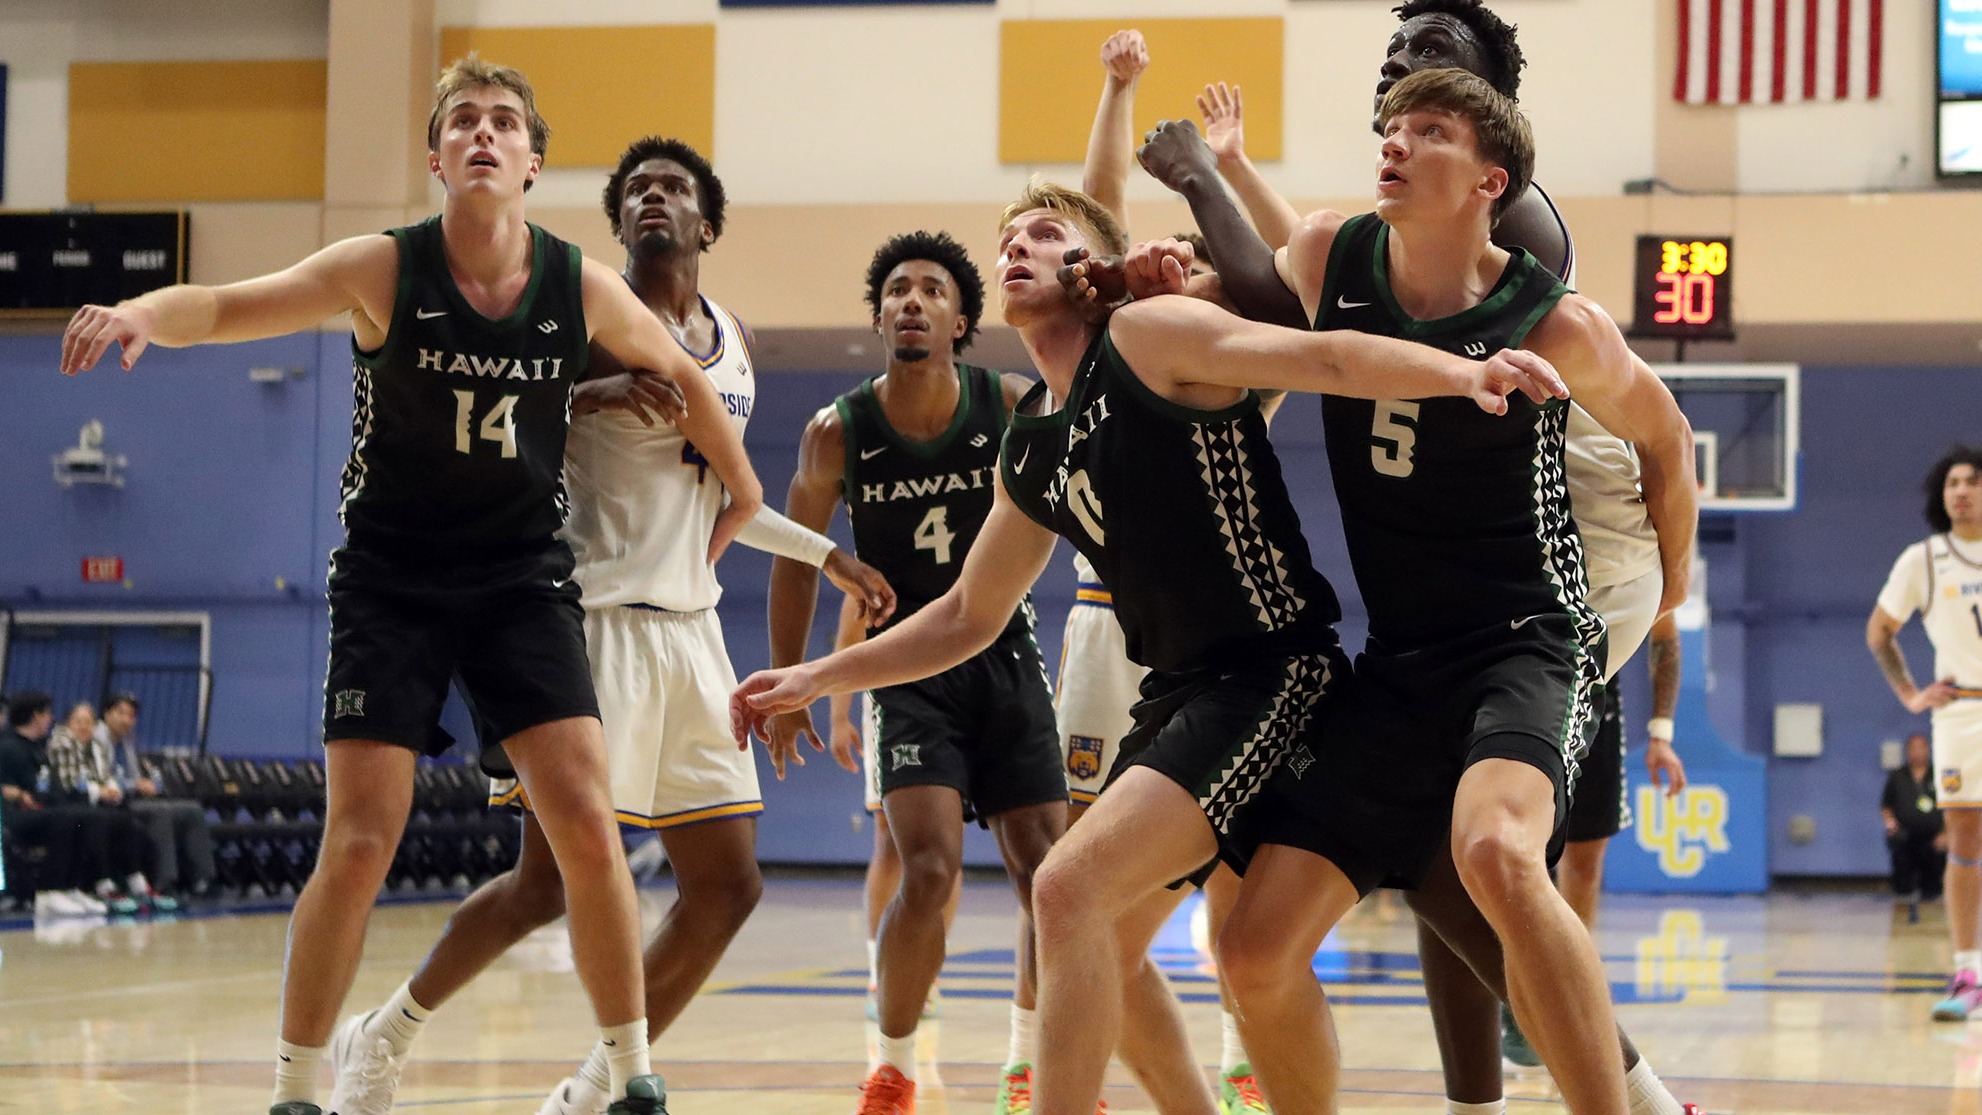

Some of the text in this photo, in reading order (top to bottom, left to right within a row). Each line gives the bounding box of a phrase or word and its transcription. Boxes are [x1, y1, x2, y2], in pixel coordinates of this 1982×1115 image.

[1661, 240, 1728, 275] 3:30
[1653, 271, 1714, 324] 30
[453, 389, 520, 459] 14
[1370, 399, 1420, 478] 5
[914, 505, 956, 565] 4
[1067, 468, 1105, 547] 0
[1636, 785, 1731, 877] UCR
